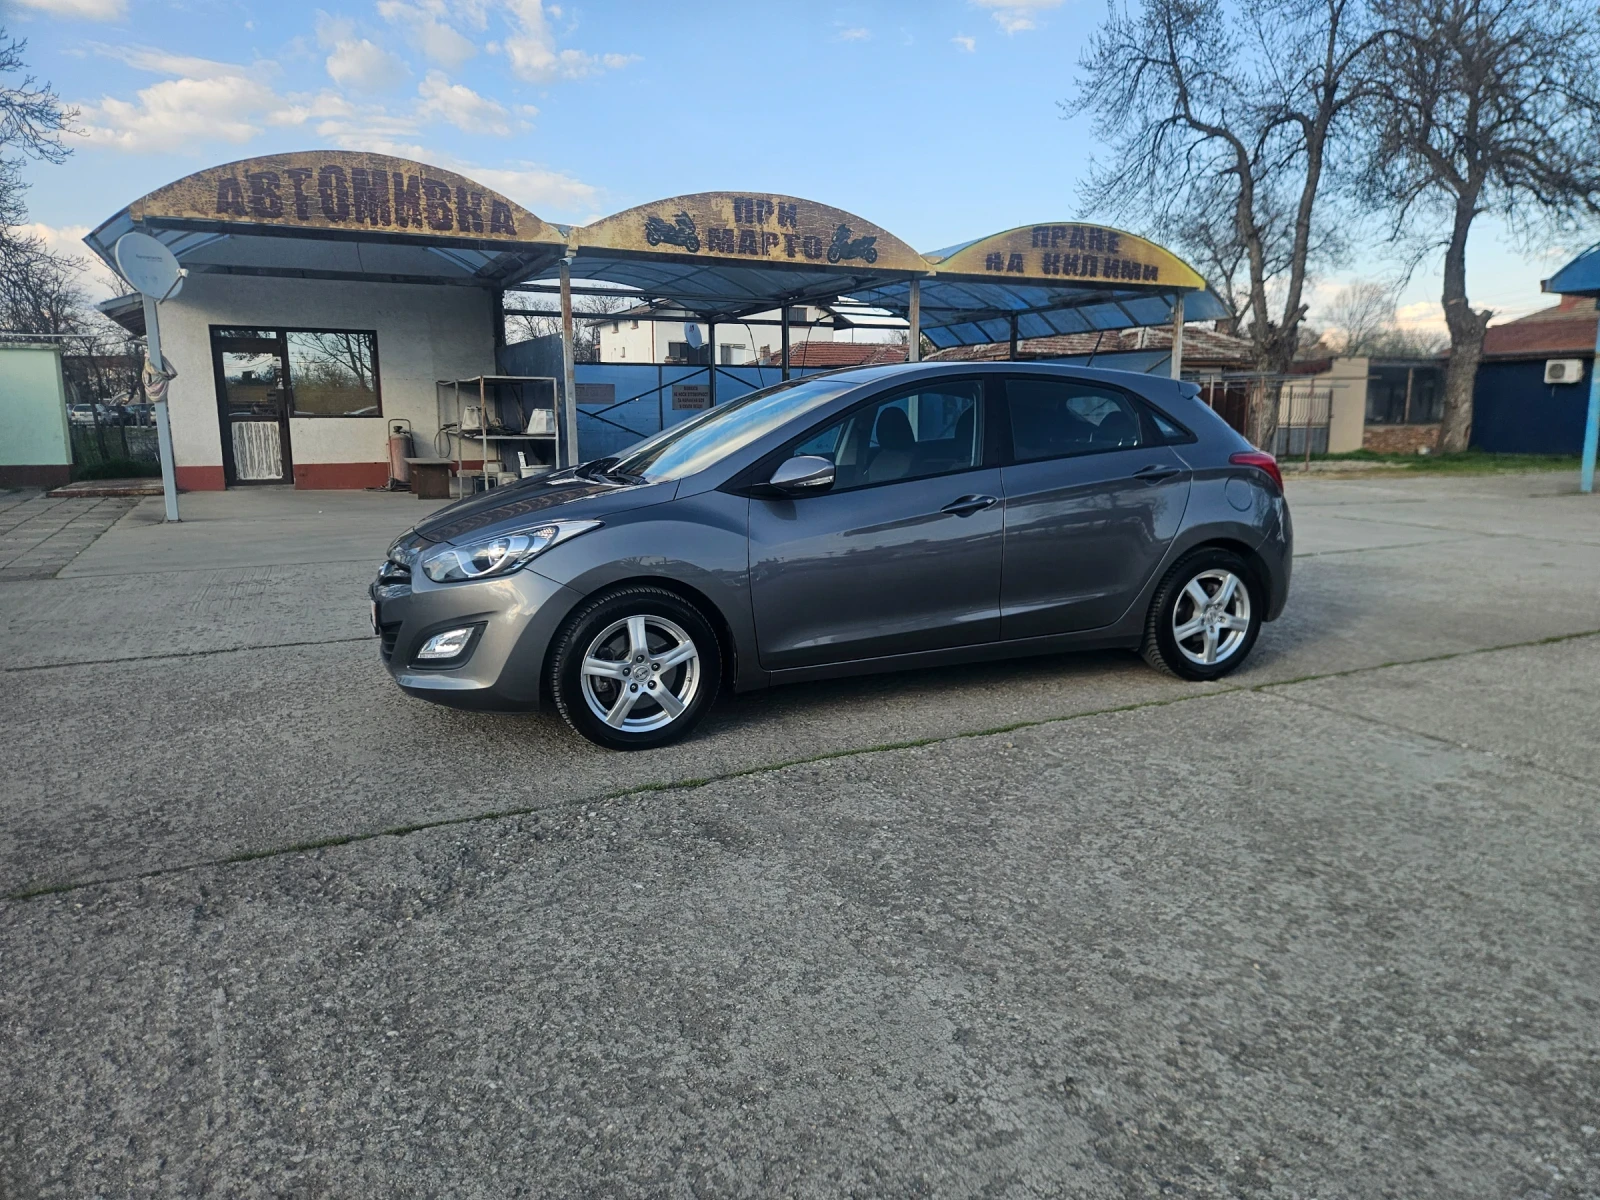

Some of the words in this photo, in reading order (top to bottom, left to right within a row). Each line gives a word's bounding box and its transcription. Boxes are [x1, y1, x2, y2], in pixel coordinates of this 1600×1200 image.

[216, 164, 517, 235] АВТОМИВКА
[734, 197, 797, 229] ПРИ
[708, 228, 822, 259] МАРТО
[1032, 226, 1120, 254] ПРАНЕ
[985, 252, 1024, 273] НА
[1042, 252, 1159, 281] КИЛИМИ
